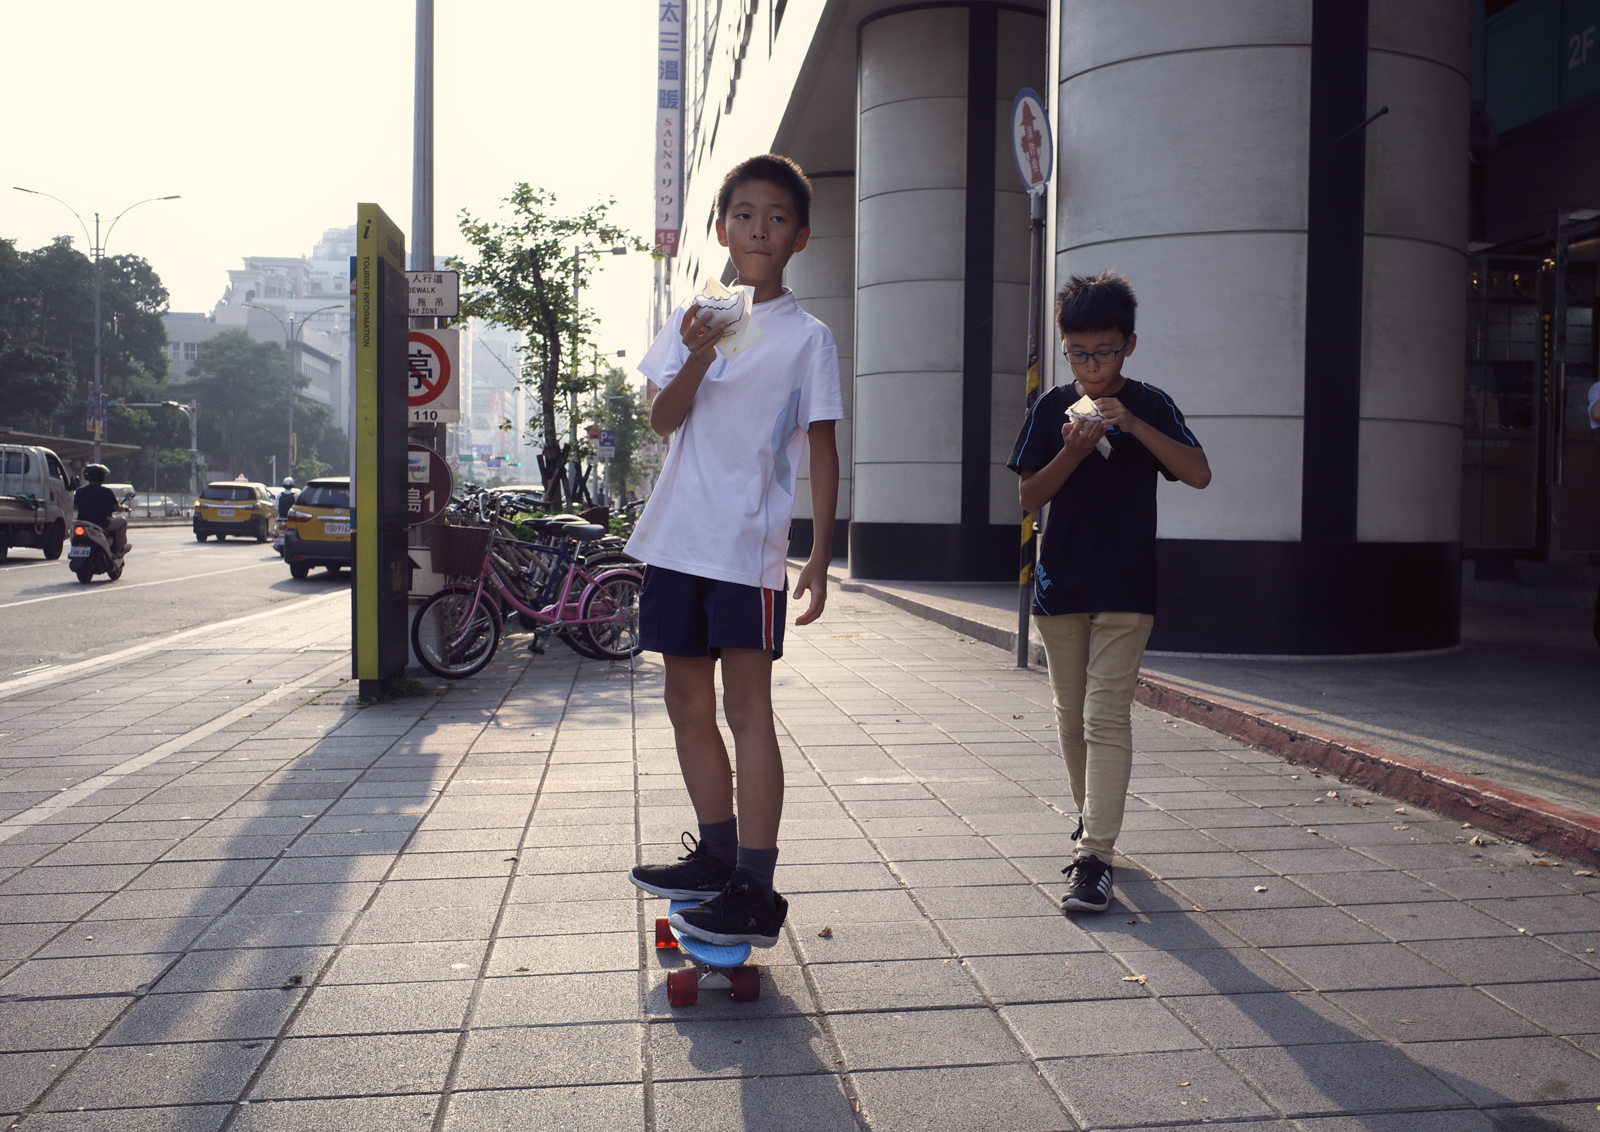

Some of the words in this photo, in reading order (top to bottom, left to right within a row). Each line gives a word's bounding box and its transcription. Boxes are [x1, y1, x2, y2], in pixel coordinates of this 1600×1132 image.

[659, 2, 680, 109] 太三溫暖
[1568, 25, 1596, 69] 2F
[663, 118, 673, 169] SAUNA
[660, 178, 674, 223] サウナ
[658, 232, 675, 243] 15
[405, 274, 443, 284] 人行道
[413, 410, 438, 420] 110
[601, 431, 608, 442] P
